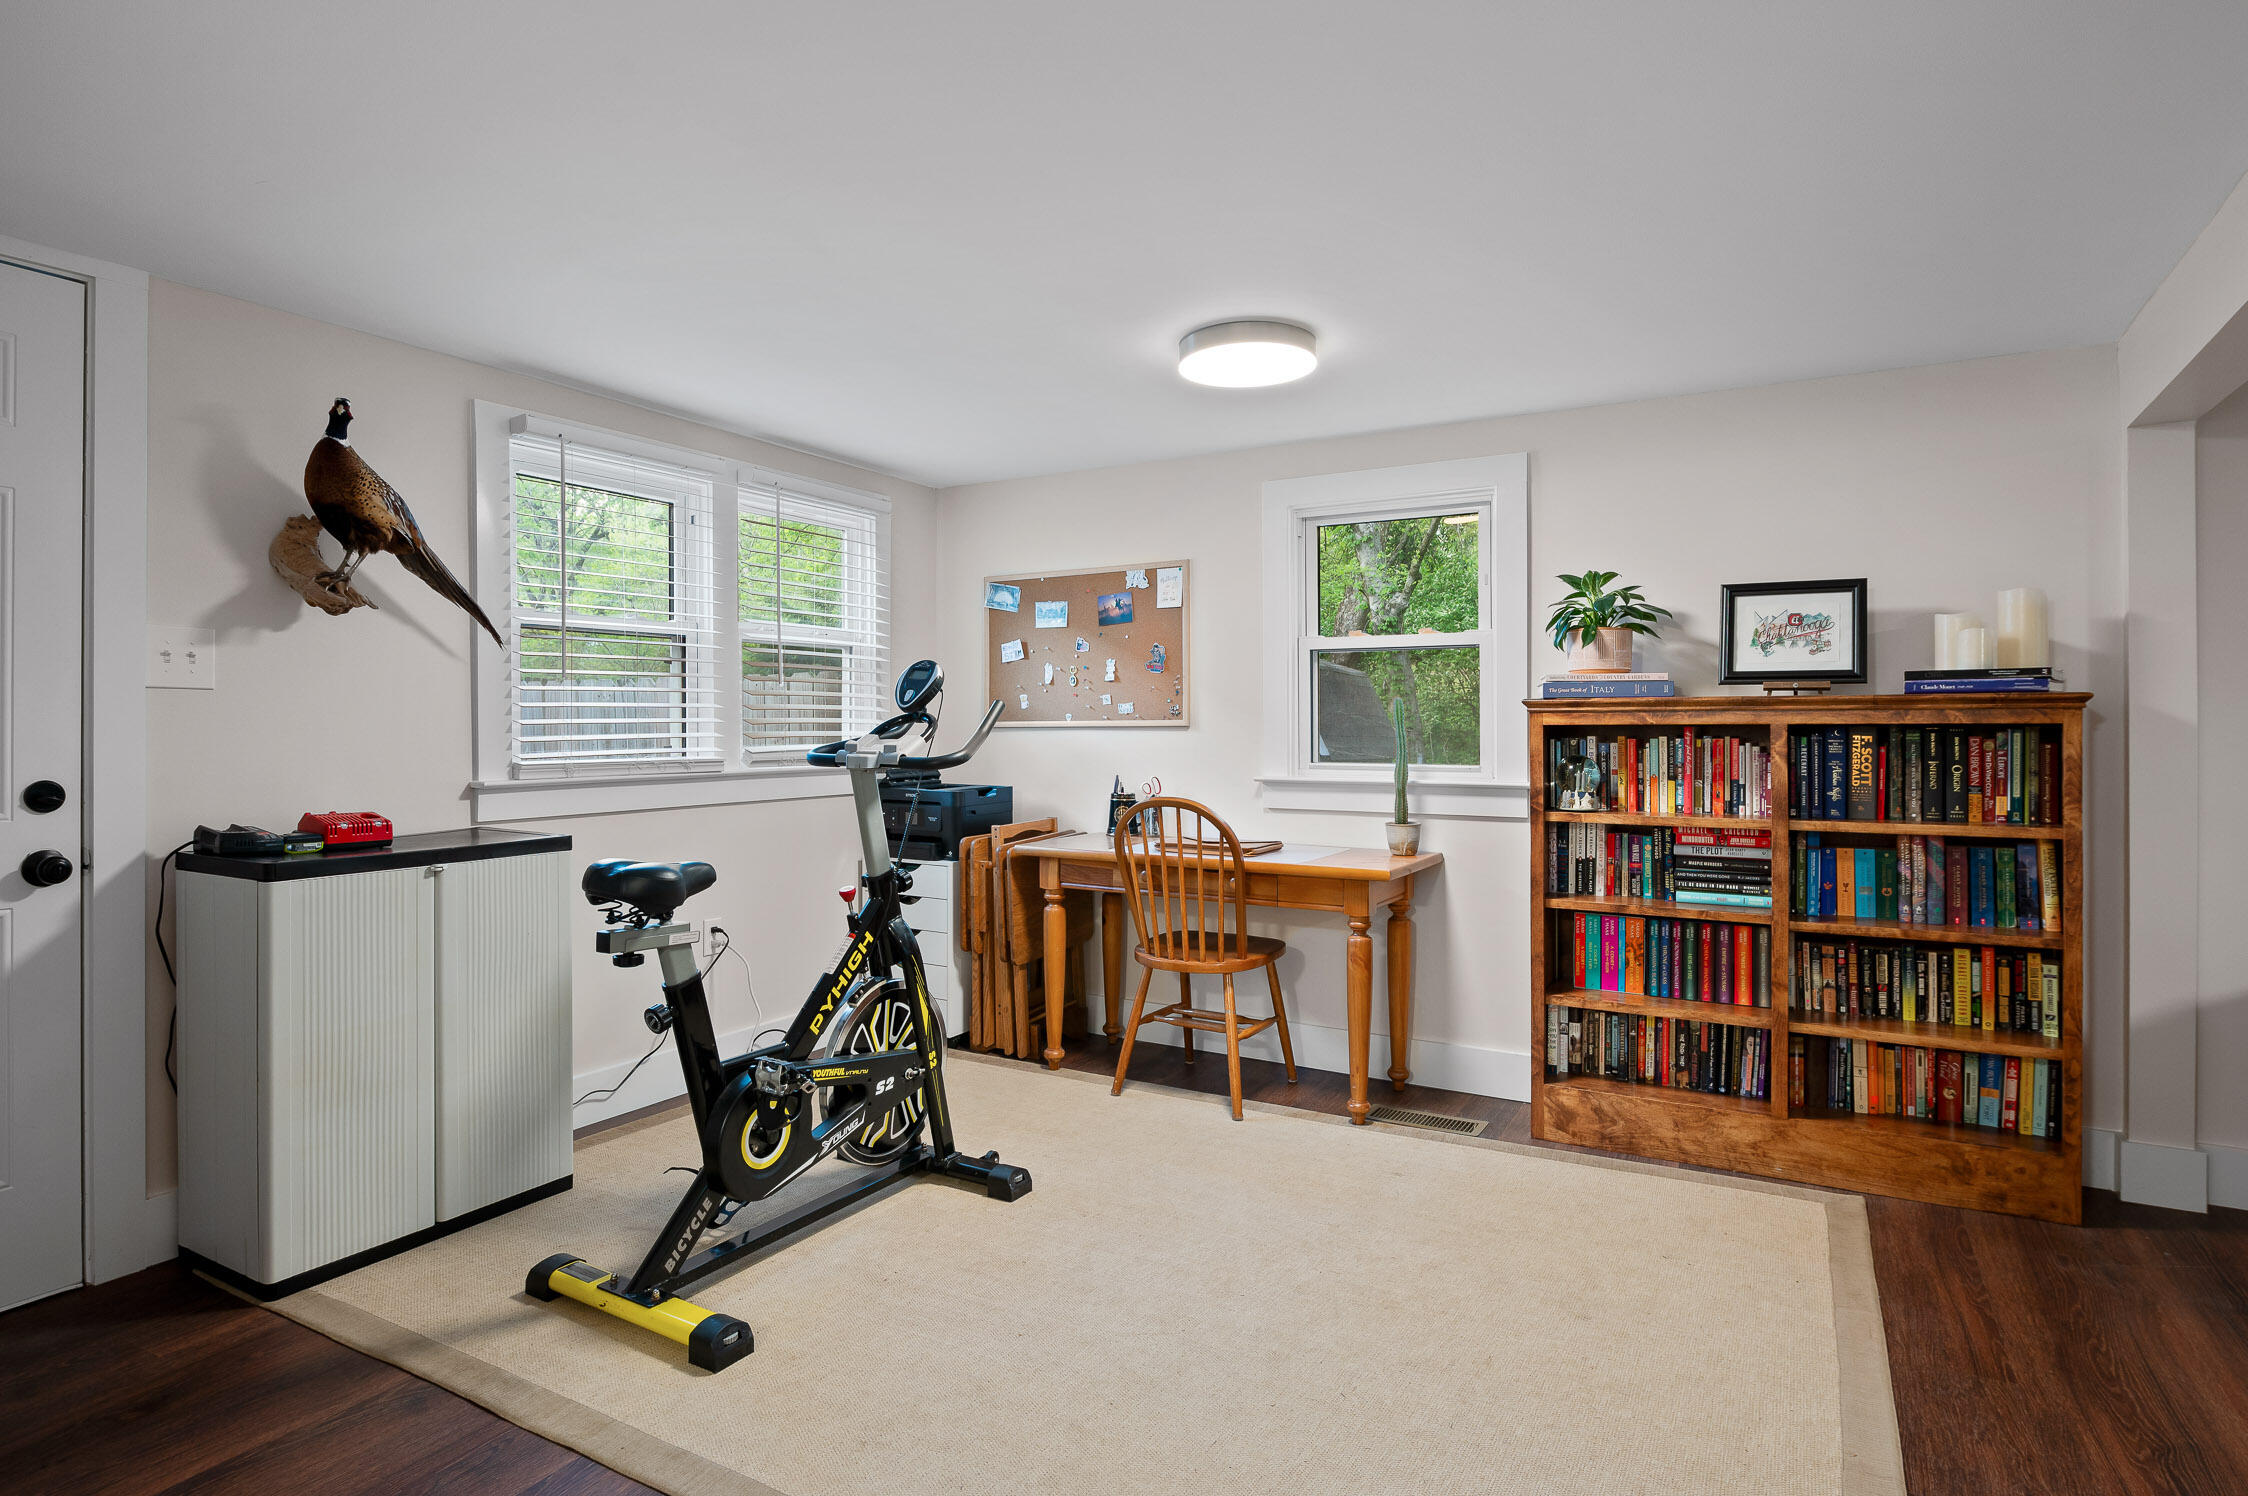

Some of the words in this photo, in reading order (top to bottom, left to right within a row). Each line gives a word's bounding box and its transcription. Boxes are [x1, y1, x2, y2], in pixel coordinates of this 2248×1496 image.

[1590, 685, 1615, 693] ITALY
[1861, 736, 1872, 744] F.
[1970, 738, 1980, 756] DAN
[1852, 735, 1860, 786] FITZGERALD
[1861, 747, 1872, 786] SCOTT
[1970, 757, 1980, 786] BROWN
[1928, 761, 1940, 790] INFERNO
[1951, 764, 1963, 792] ORIGIN
[1682, 836, 1714, 844] MINDHUNTER
[1706, 846, 1723, 855] PLOT
[1958, 954, 1967, 980] MICHAEL
[810, 930, 874, 1035] PYHIGH
[1958, 985, 1968, 1016] CRICHTON
[812, 1068, 845, 1078] YOUTHFUL
[929, 1050, 937, 1069] S2
[875, 1076, 895, 1096] S2
[822, 1118, 859, 1148] YOUNG
[664, 1197, 713, 1274] BICYCLE
